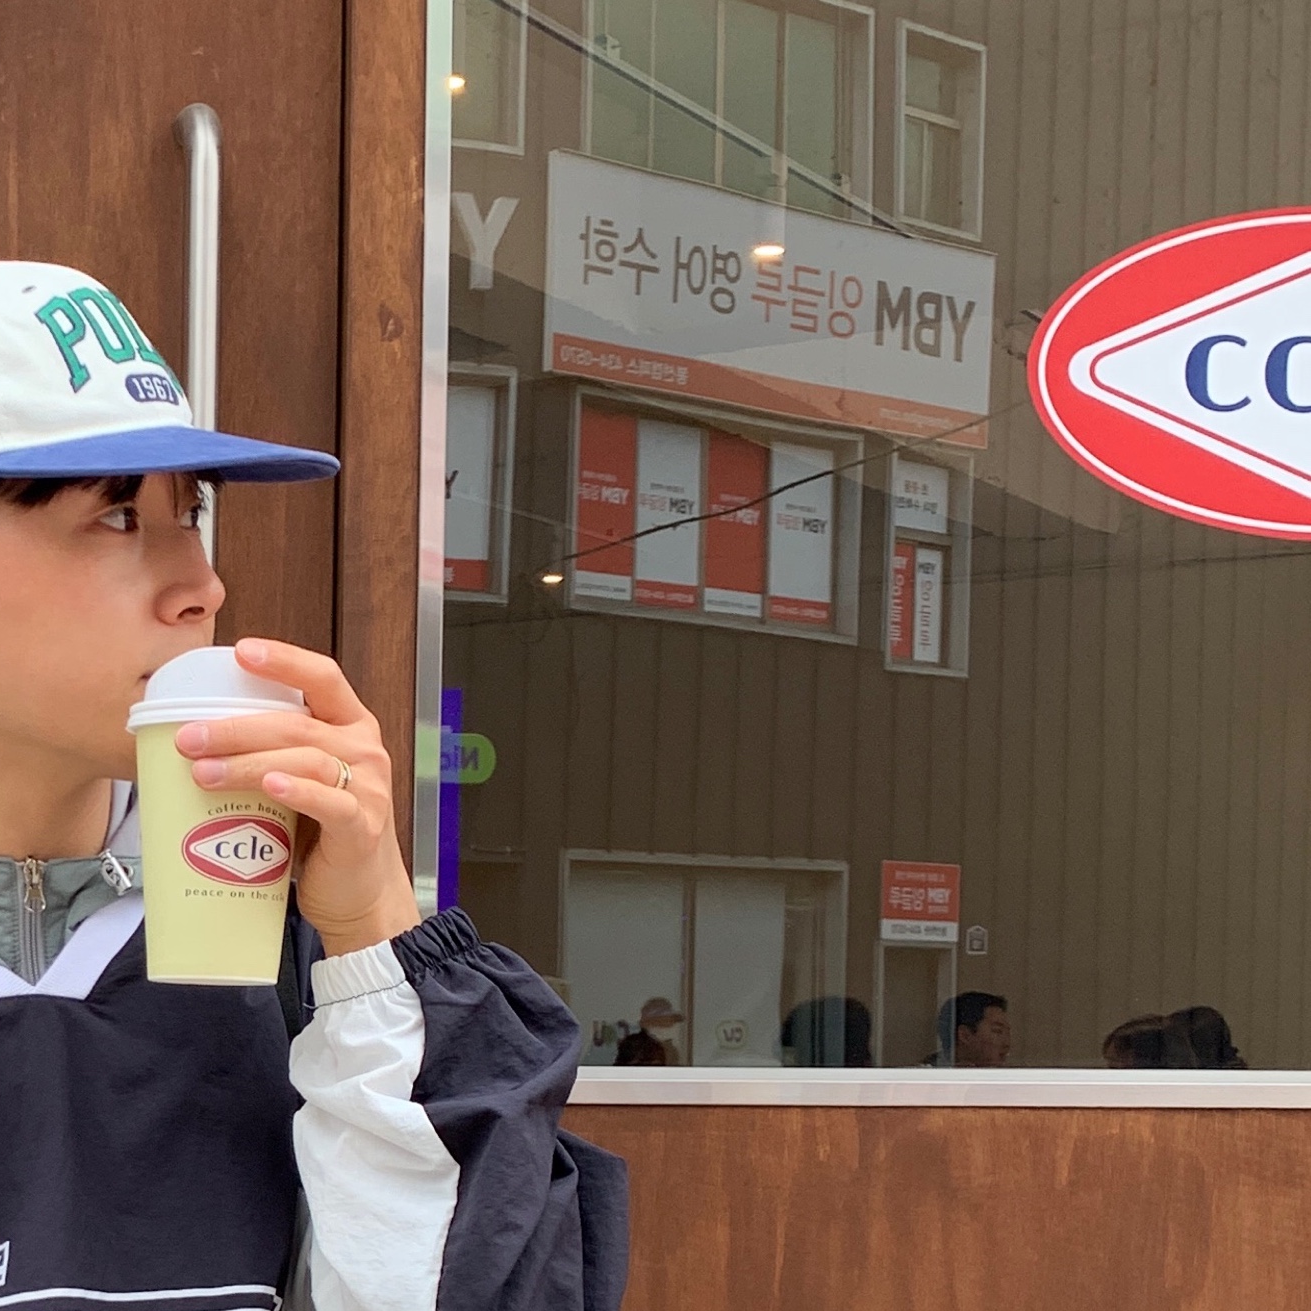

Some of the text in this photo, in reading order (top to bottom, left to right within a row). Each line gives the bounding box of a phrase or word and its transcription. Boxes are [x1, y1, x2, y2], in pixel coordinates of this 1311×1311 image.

[132, 377, 174, 402] 1967
[207, 802, 251, 816] coffee
[215, 835, 273, 862] ccle
[185, 888, 224, 898] peace
[230, 889, 245, 899] on
[251, 889, 268, 900] the
